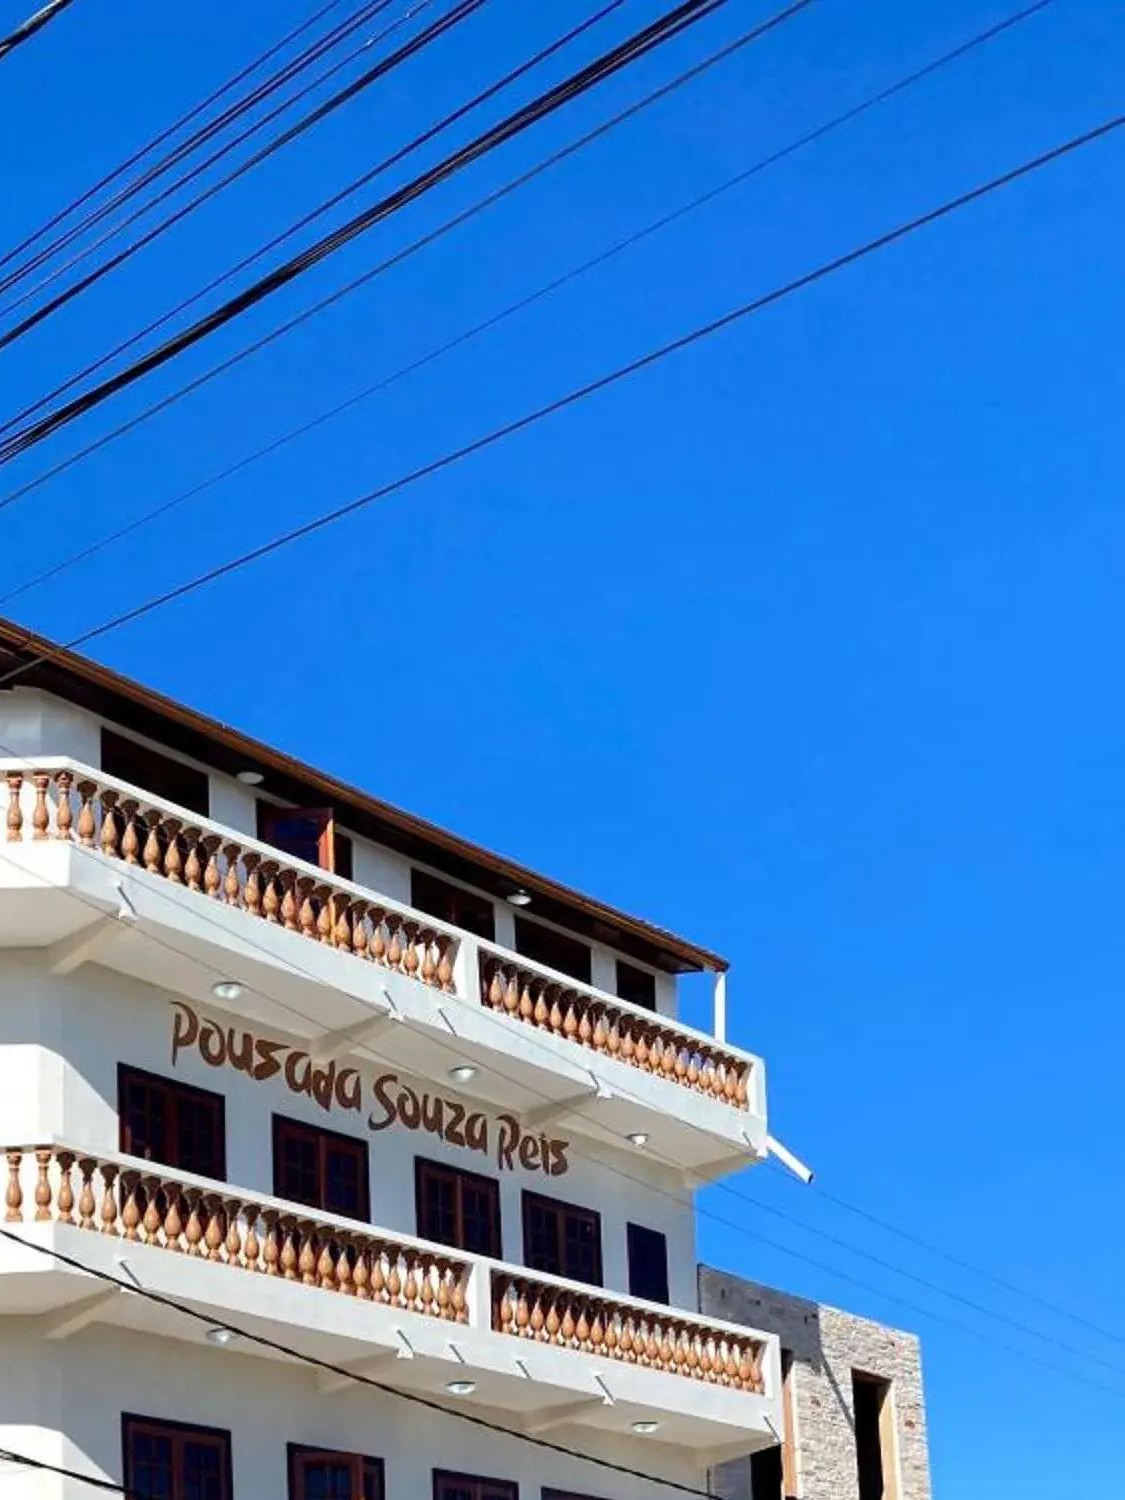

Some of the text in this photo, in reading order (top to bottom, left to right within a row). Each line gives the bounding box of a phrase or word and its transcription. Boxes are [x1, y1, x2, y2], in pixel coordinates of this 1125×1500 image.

[170, 1001, 571, 1177] Pousada Souza Reis
